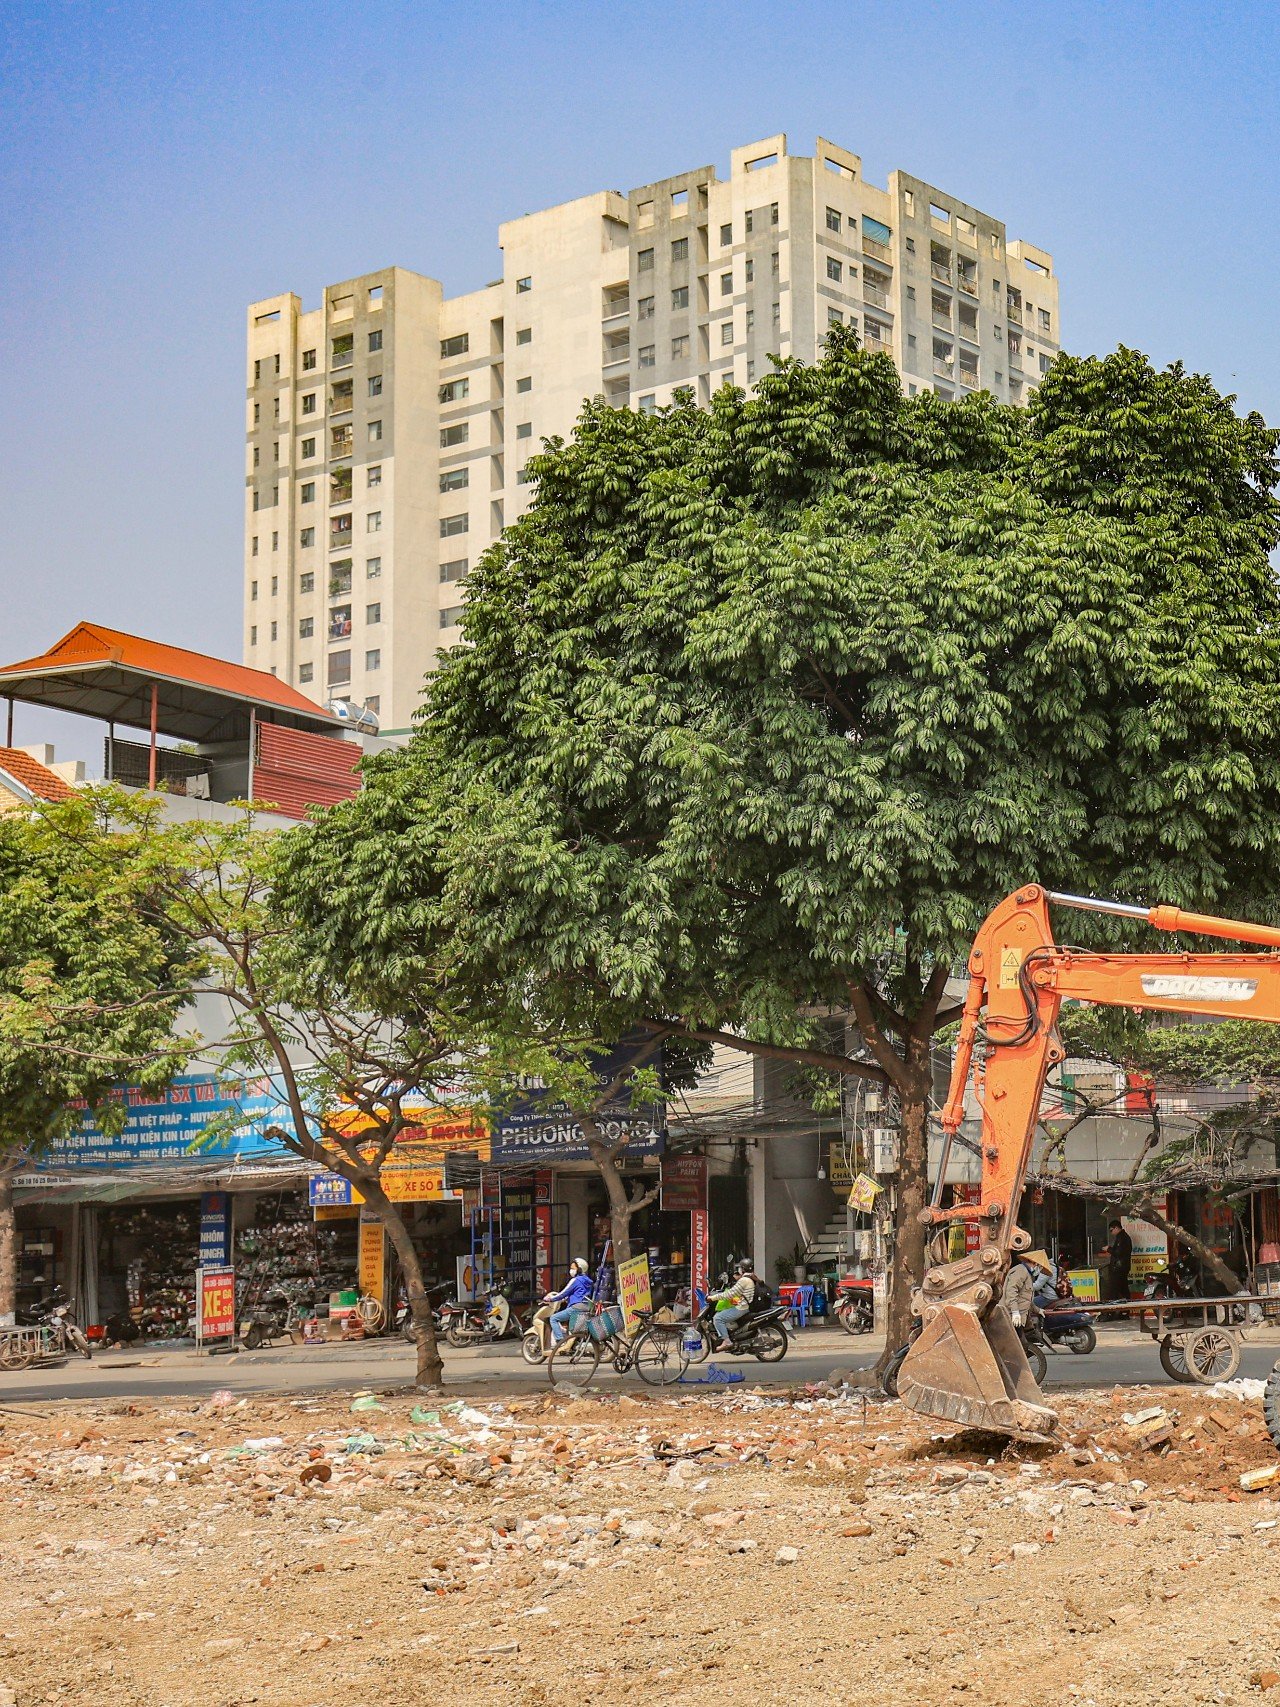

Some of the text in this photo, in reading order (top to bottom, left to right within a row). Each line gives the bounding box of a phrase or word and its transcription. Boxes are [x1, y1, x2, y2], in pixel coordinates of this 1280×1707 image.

[1152, 978, 1250, 997] DOOSAN
[170, 1080, 216, 1105] SX VÀ
[139, 1113, 158, 1129] VIỆT
[159, 1113, 183, 1126] PHÁP
[66, 1135, 86, 1149] KIỆN
[120, 1133, 139, 1147] PHỤ
[140, 1131, 161, 1145] KIỆN
[162, 1130, 178, 1142] KIN
[404, 1178, 434, 1192] XE SỐ
[200, 1230, 225, 1243] NHÔM
[695, 1213, 703, 1250] PAINT
[198, 1247, 225, 1260] XINGFA
[222, 1289, 233, 1301] GA
[203, 1292, 223, 1320] XE
[222, 1302, 233, 1316] SỐ
